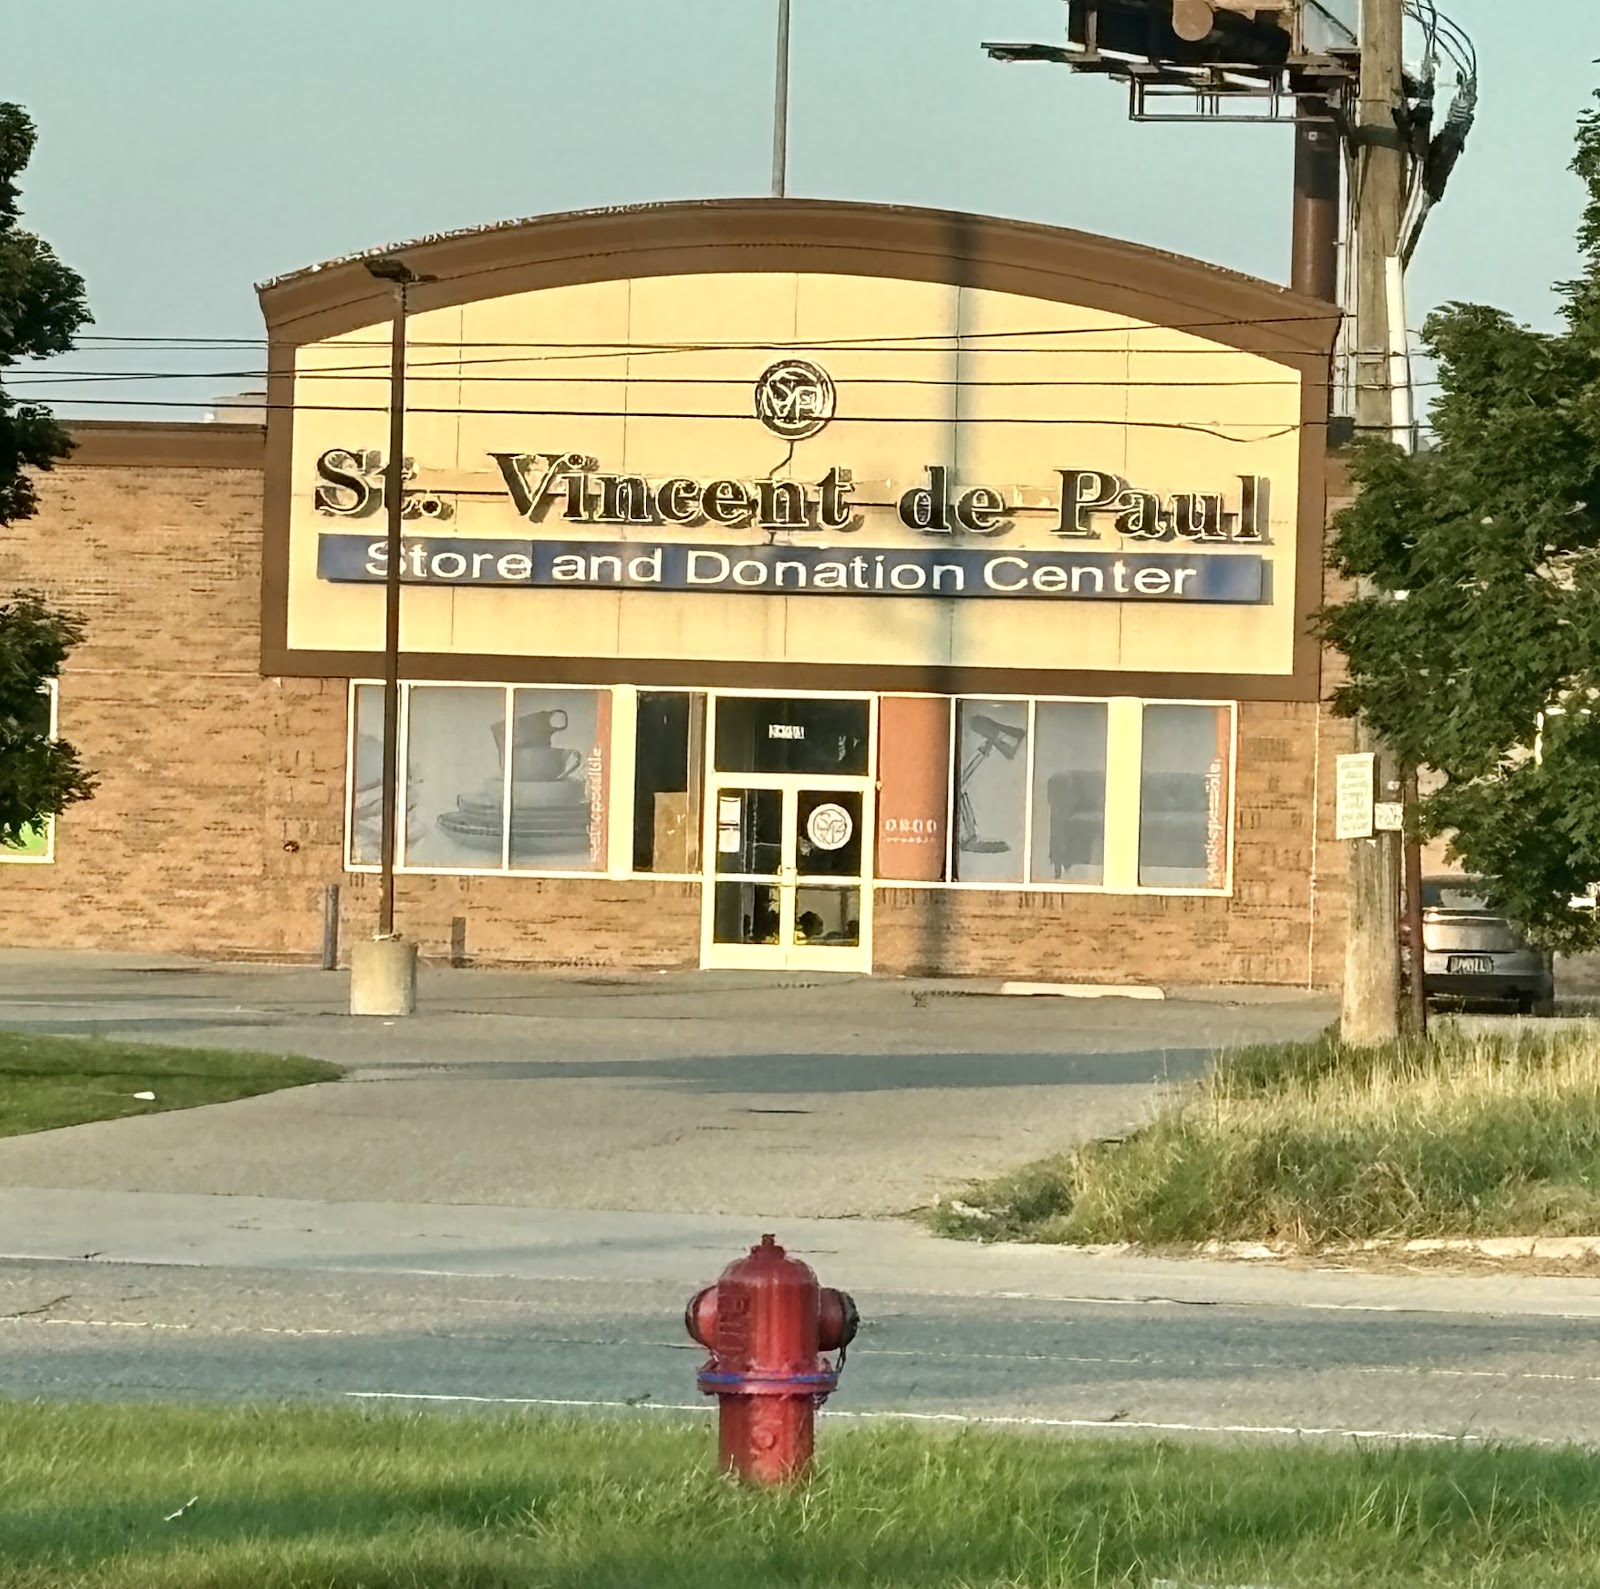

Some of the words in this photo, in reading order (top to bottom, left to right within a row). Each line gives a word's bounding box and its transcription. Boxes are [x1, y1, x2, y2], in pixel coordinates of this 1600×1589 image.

[486, 452, 858, 528] Vincent
[899, 465, 1006, 533] de
[1051, 468, 1264, 542] Paul
[365, 540, 532, 580] Store
[552, 548, 662, 584] and
[686, 549, 966, 593] Donation
[983, 555, 1199, 596] Center
